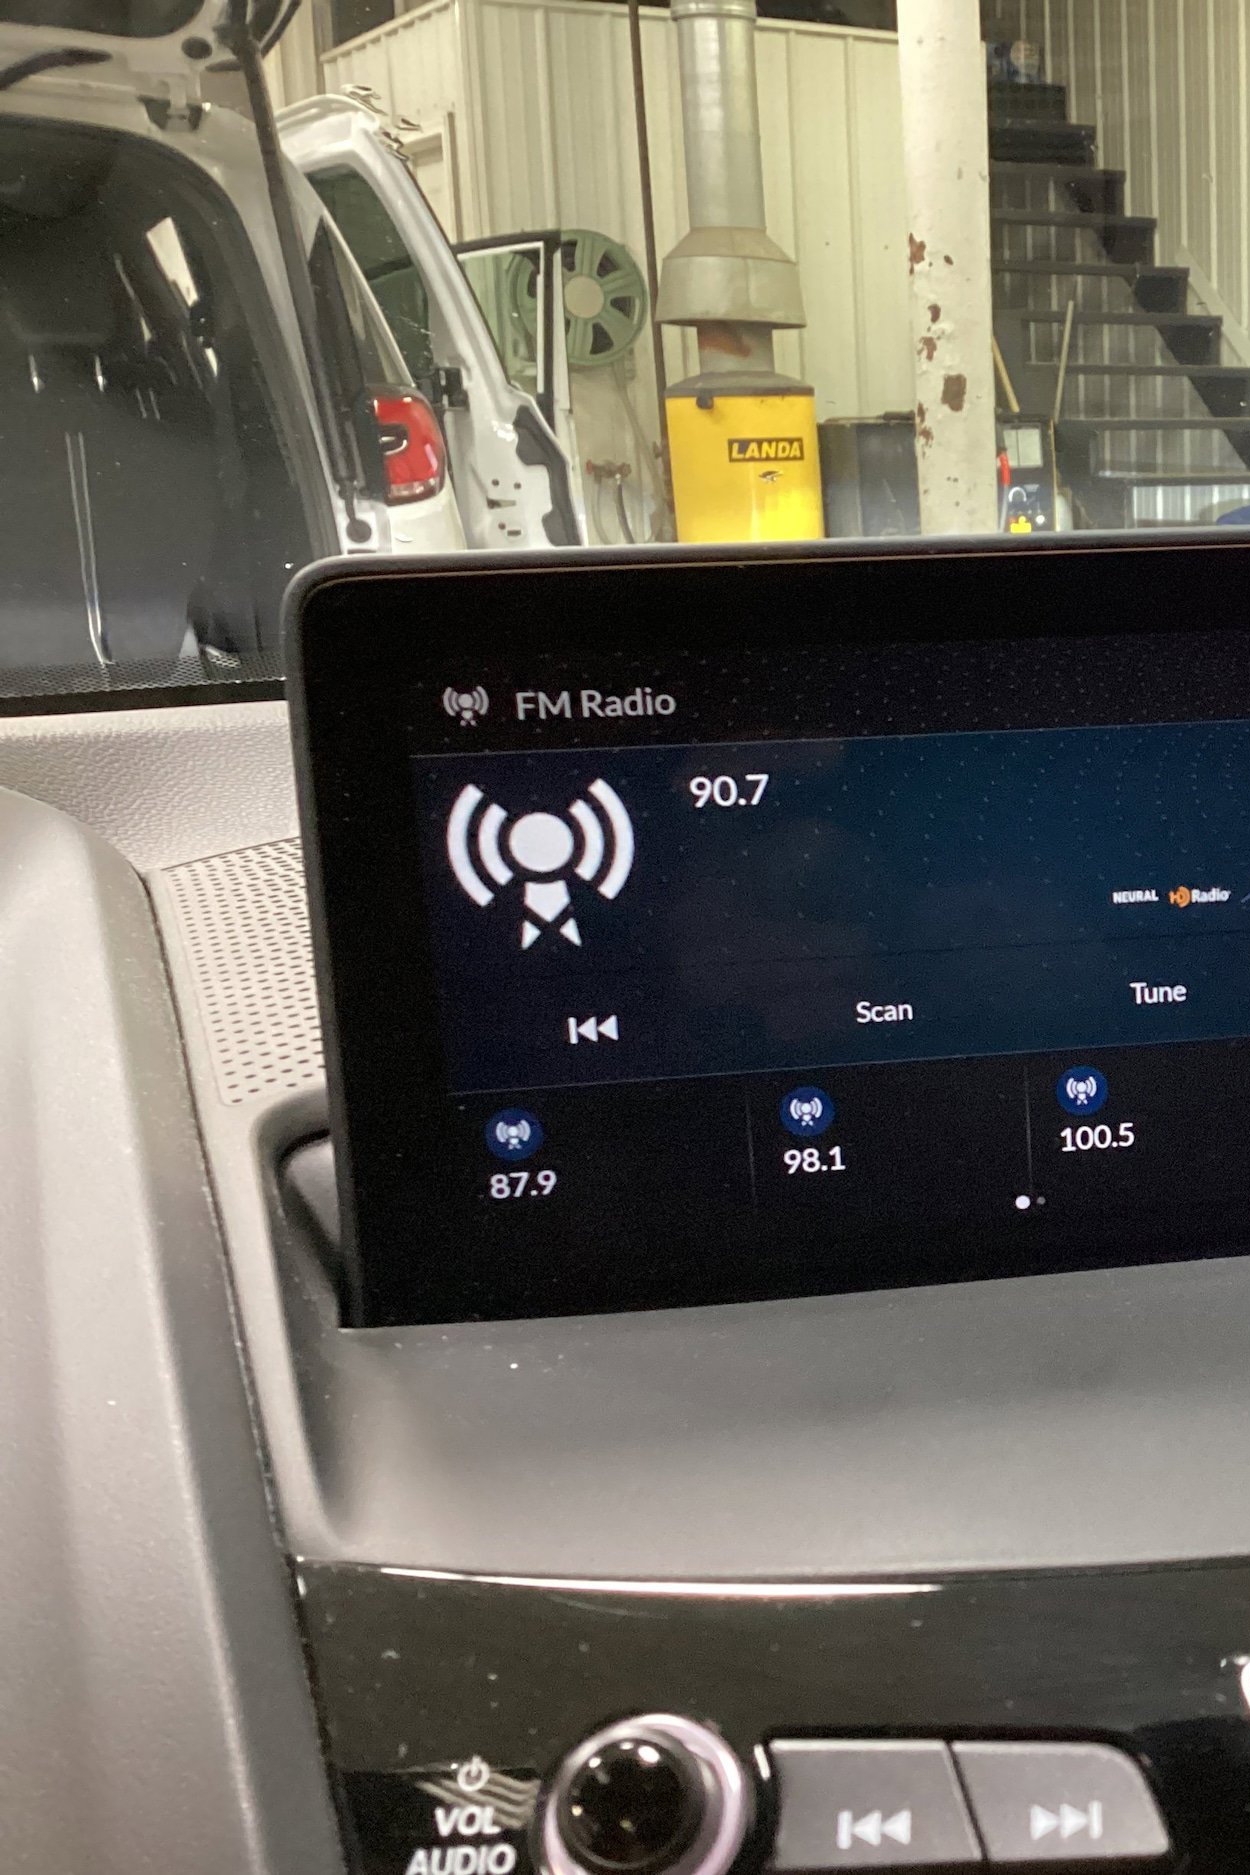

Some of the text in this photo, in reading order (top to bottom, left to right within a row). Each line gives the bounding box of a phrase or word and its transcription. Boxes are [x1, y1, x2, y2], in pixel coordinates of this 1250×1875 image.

[731, 441, 801, 459] LANDA
[515, 686, 677, 720] FM Radio
[689, 773, 770, 809] 90.7
[1112, 889, 1159, 904] NEURAL
[1129, 981, 1188, 1006] Tune
[856, 1000, 915, 1025] Scan
[1059, 1121, 1136, 1153] 100.5
[782, 1144, 847, 1175] 98.1
[489, 1168, 558, 1200] 87.9
[434, 1805, 502, 1837] VOL
[404, 1843, 517, 1875] AUDIO
